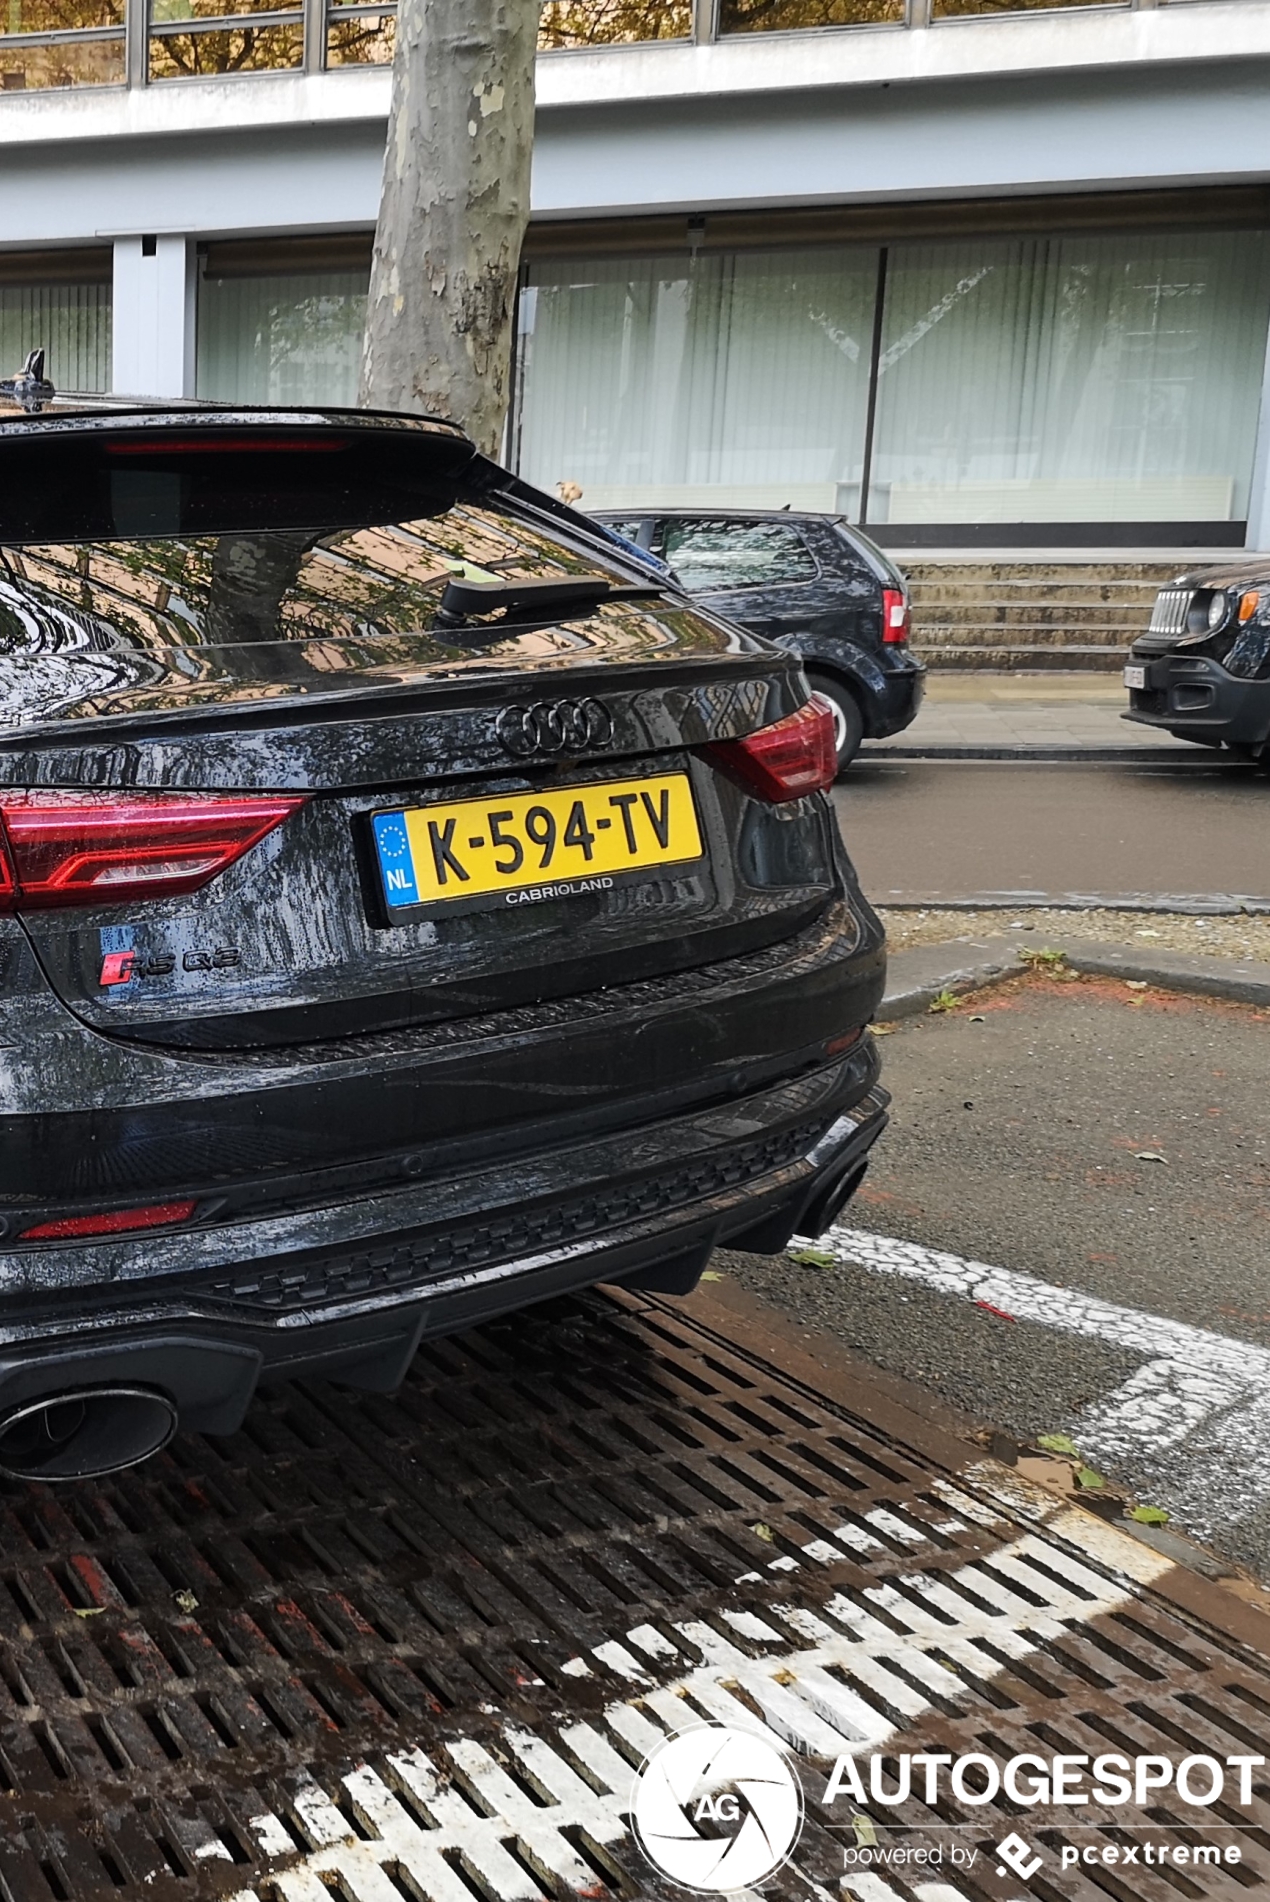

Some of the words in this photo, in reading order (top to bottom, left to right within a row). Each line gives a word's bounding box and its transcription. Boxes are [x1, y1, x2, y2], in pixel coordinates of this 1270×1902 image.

[427, 789, 669, 885] K-594-TV
[386, 868, 413, 891] NL
[505, 877, 614, 904] CABRIOLAND
